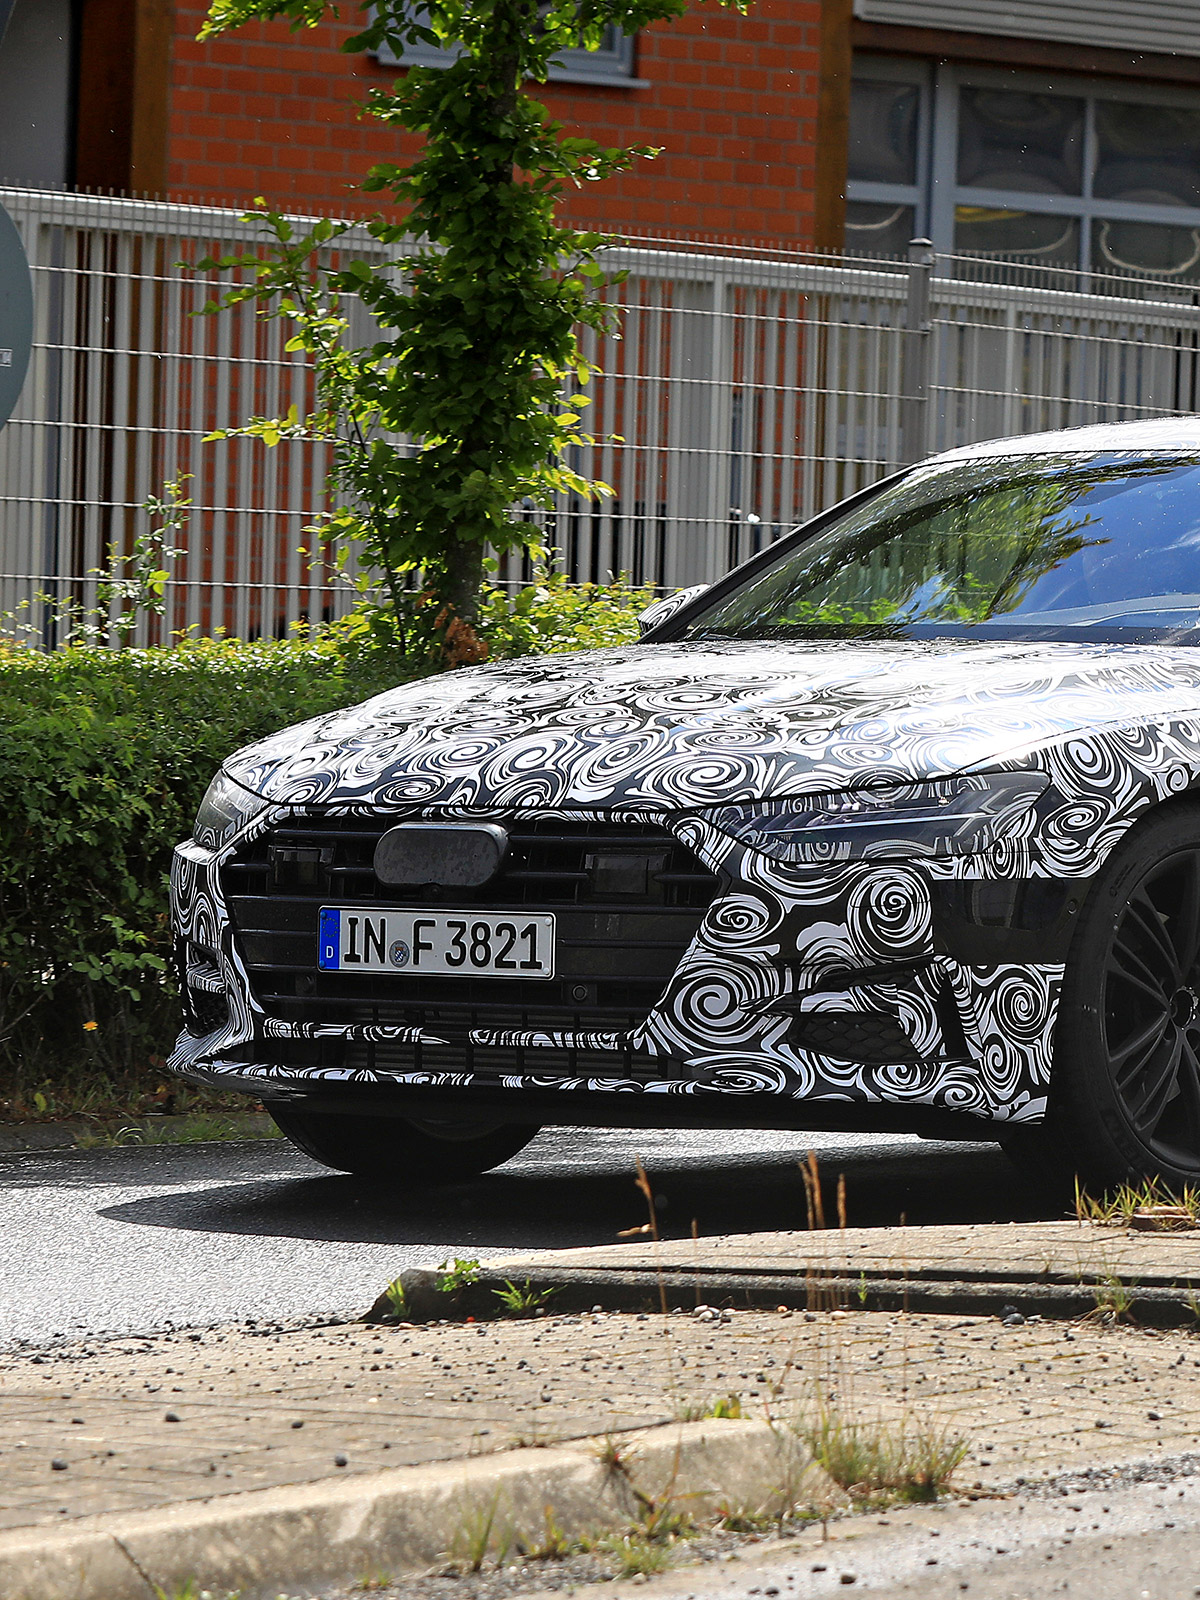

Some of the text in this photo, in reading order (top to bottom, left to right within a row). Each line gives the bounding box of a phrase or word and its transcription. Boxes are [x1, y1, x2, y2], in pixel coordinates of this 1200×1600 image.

[325, 945, 335, 959] D
[343, 916, 544, 970] IN F 3821
